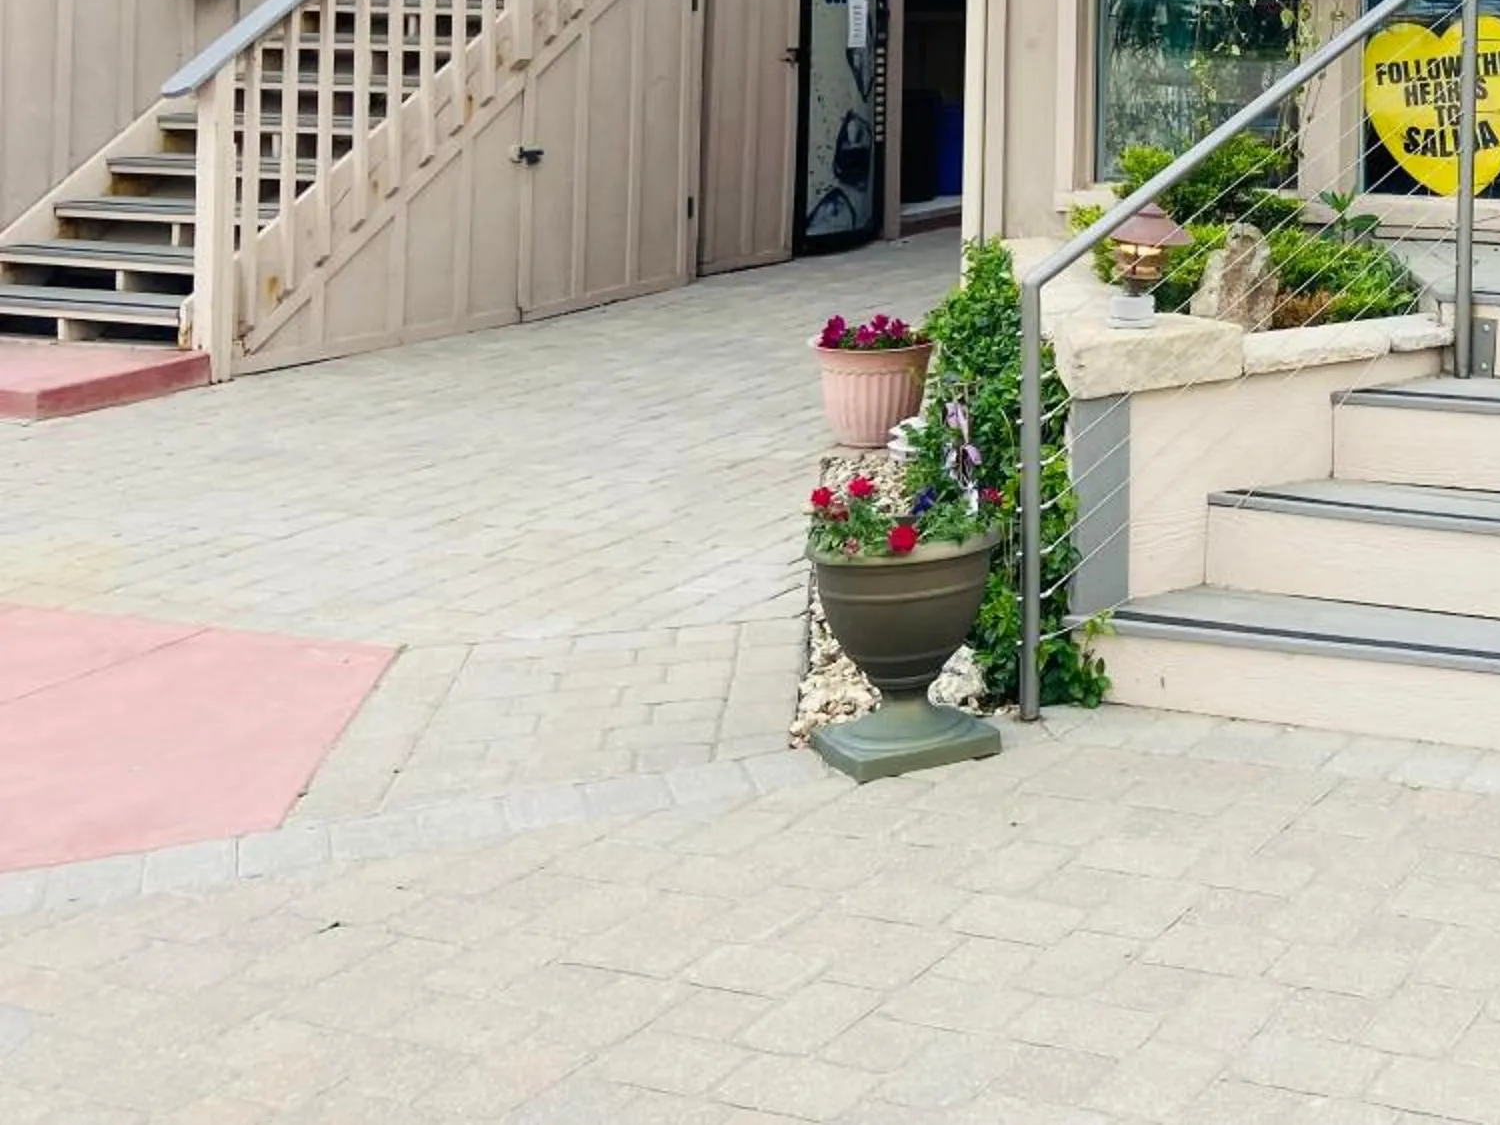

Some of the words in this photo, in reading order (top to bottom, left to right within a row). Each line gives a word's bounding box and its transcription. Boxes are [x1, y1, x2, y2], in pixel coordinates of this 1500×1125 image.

[1375, 55, 1463, 86] FOLLOW
[1404, 76, 1489, 108] HEARS
[1403, 120, 1500, 158] SALIA
